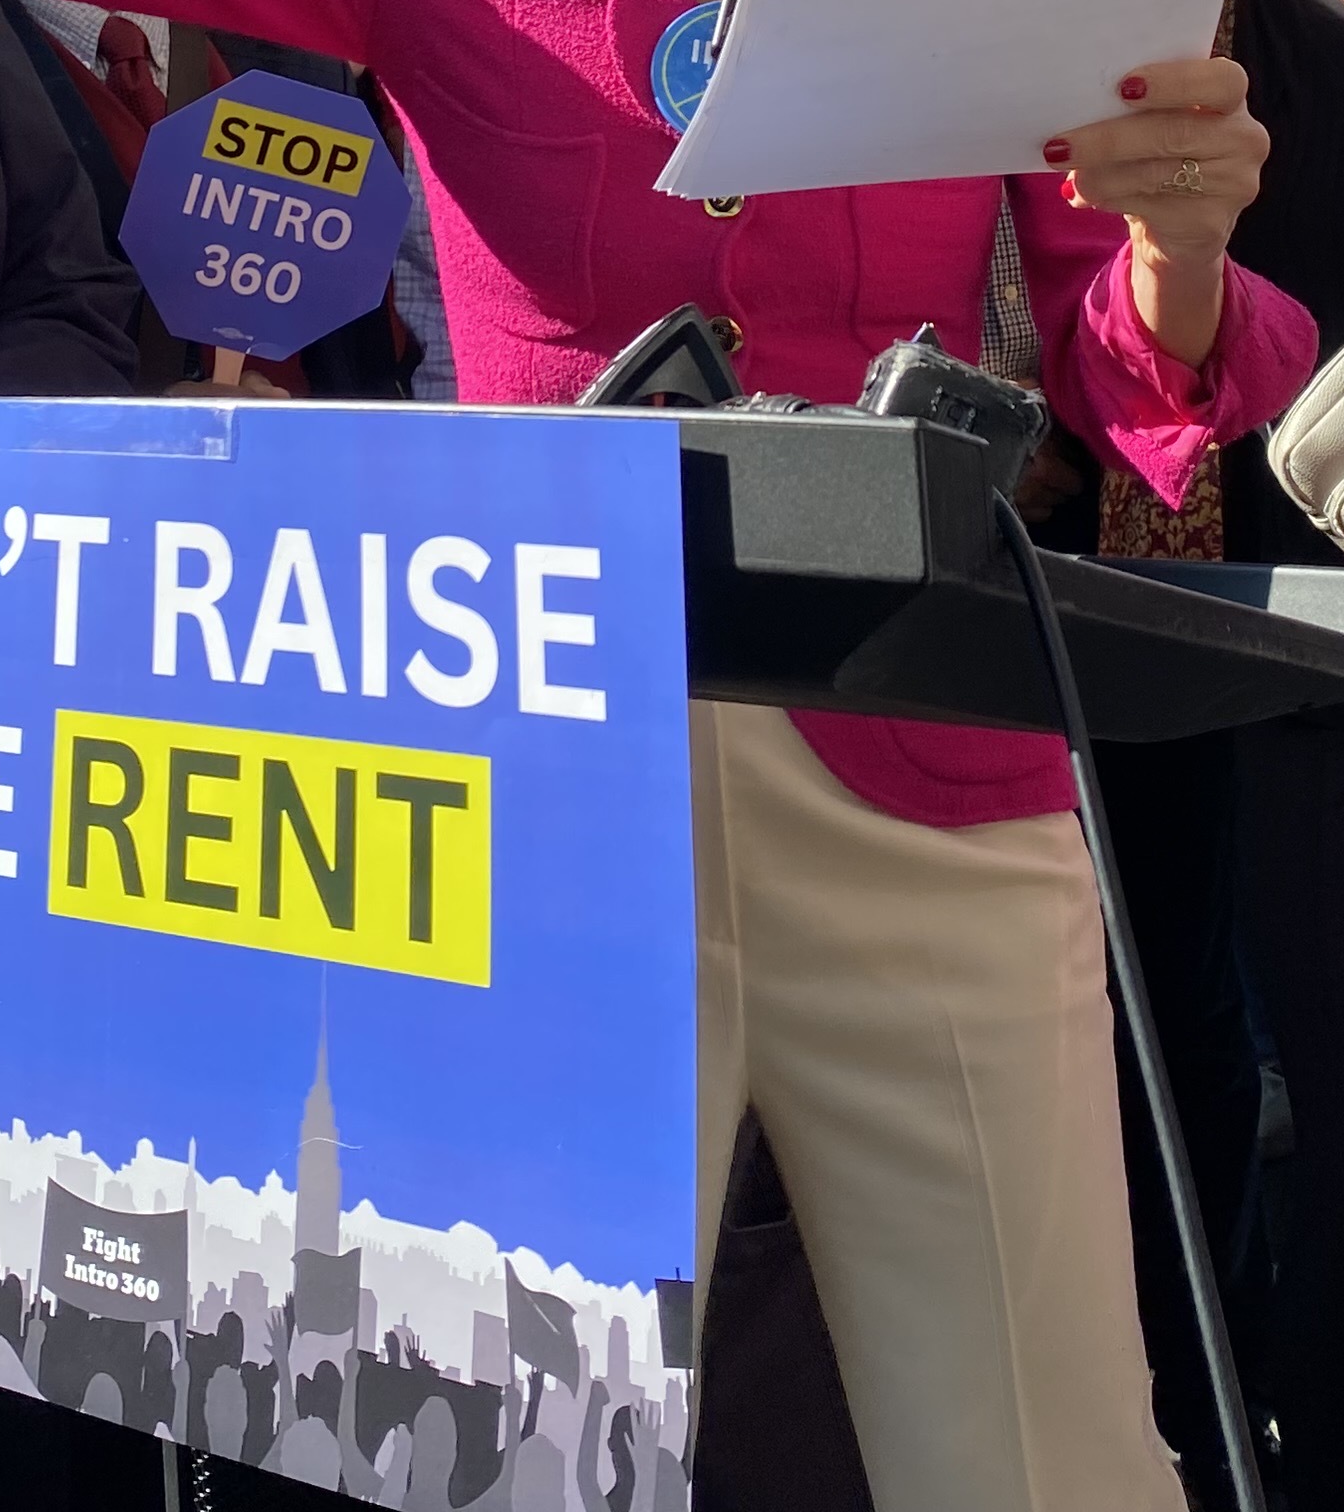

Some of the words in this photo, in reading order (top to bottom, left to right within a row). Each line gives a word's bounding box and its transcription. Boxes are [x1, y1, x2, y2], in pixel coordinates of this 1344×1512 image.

[214, 116, 359, 184] STOP
[182, 173, 353, 251] INTRO
[194, 244, 302, 304] 360
[152, 519, 608, 723] RAISE
[66, 736, 469, 946] RENT
[64, 1253, 120, 1292] Intro
[121, 1272, 160, 1302] 360
[82, 1226, 141, 1264] Fight
